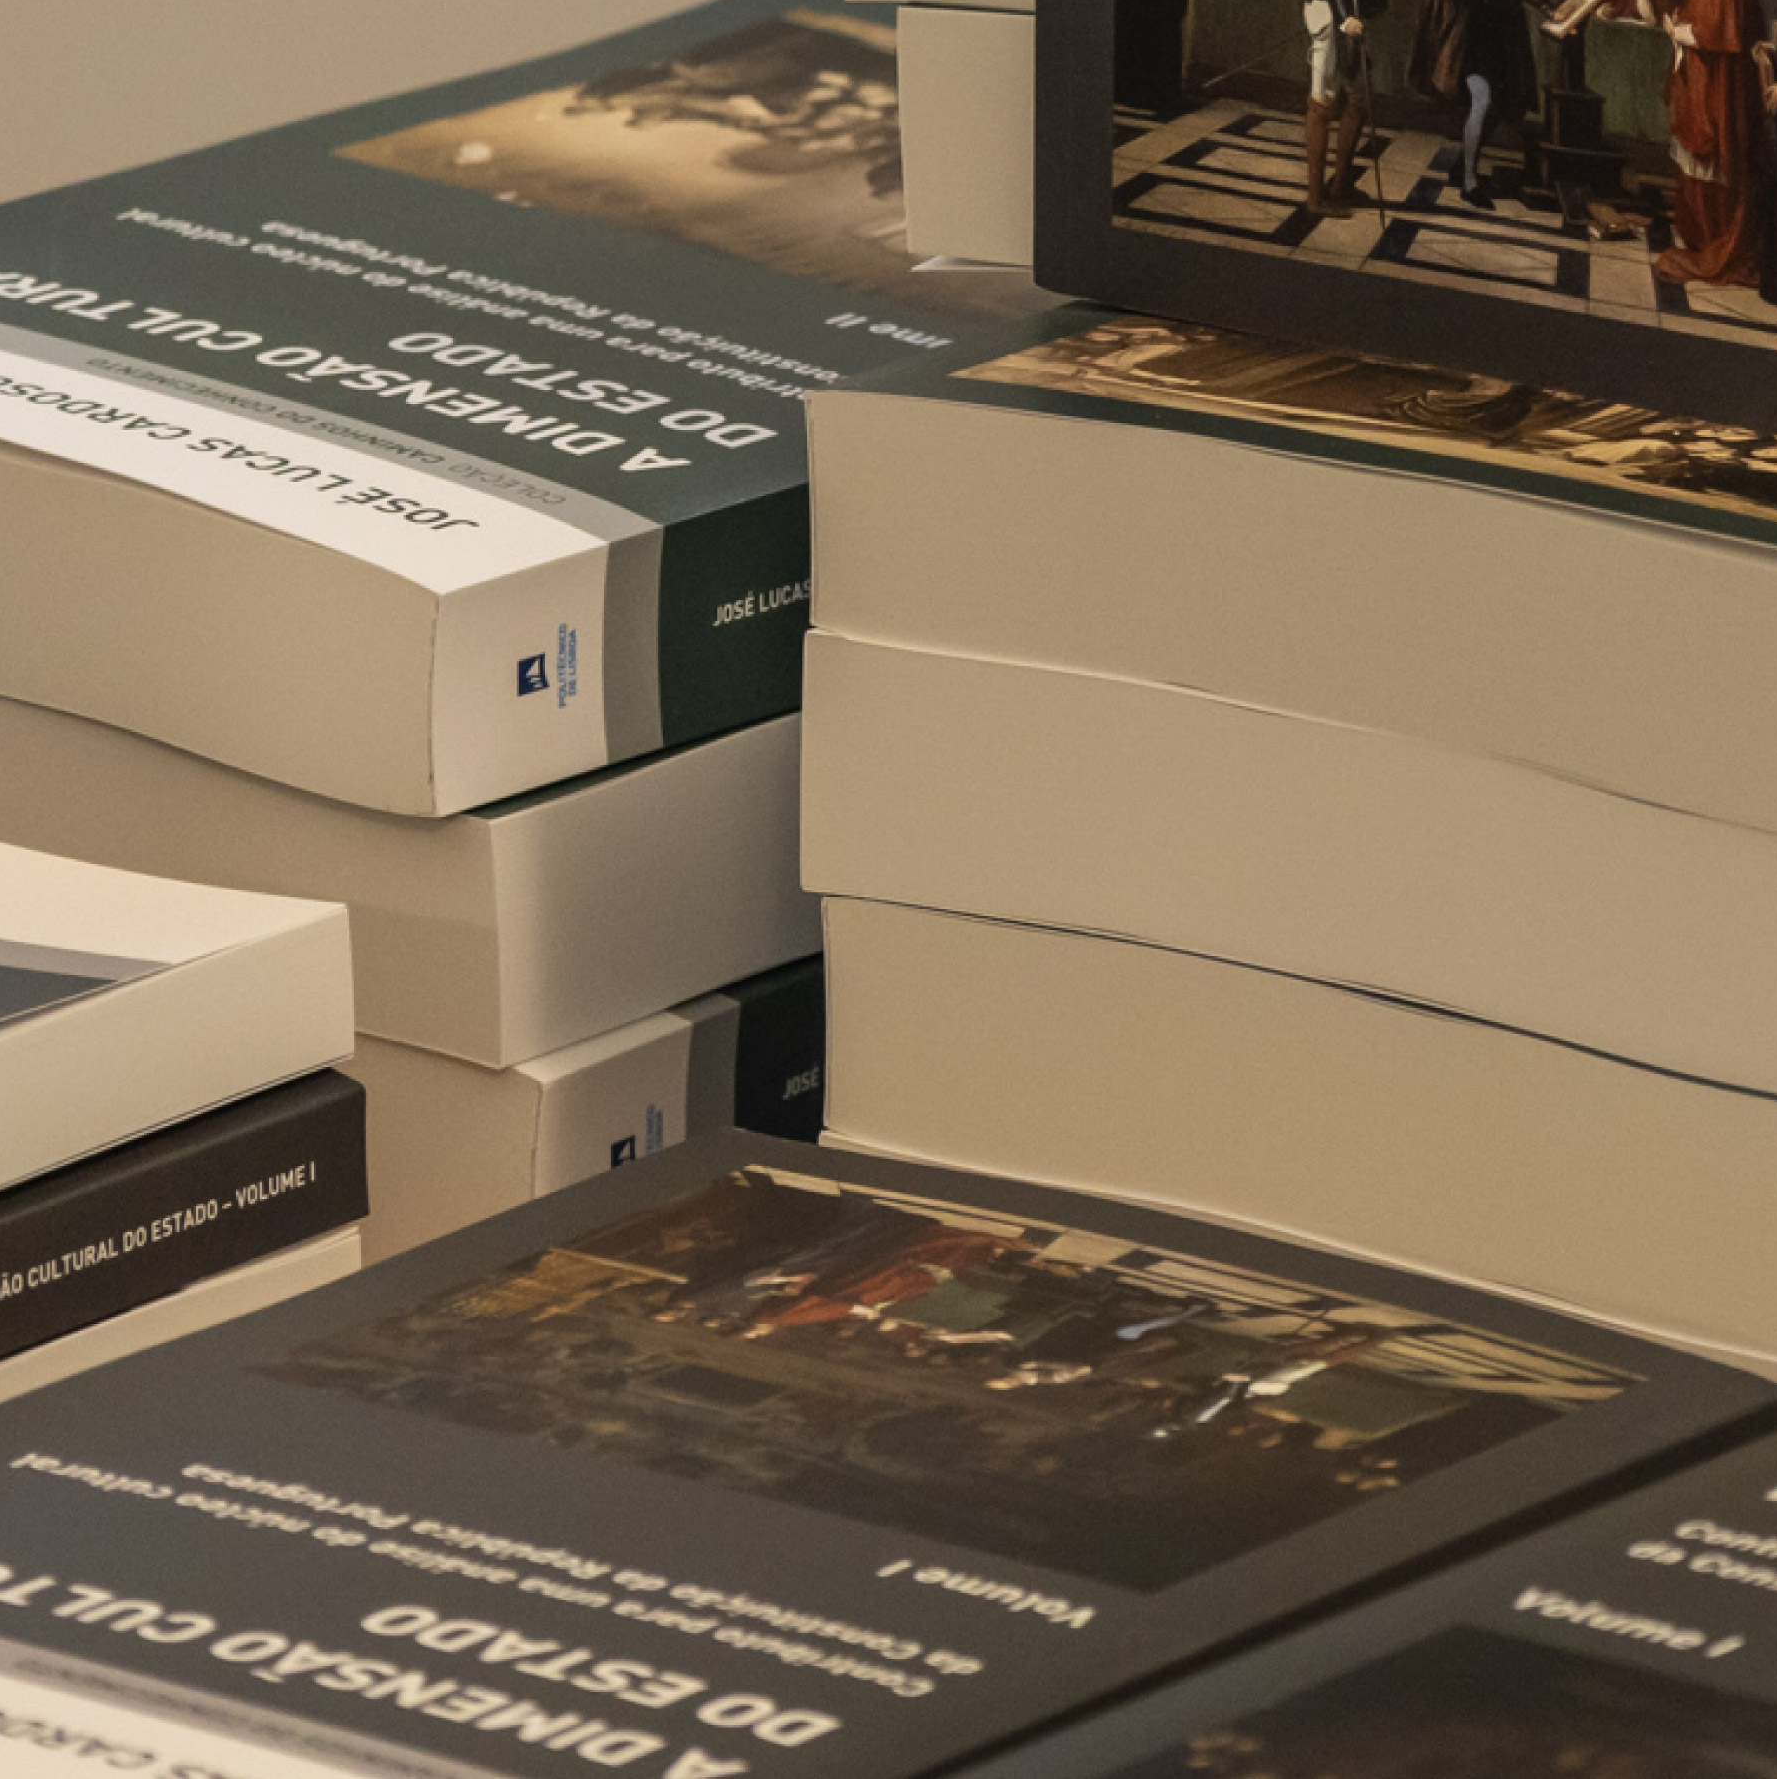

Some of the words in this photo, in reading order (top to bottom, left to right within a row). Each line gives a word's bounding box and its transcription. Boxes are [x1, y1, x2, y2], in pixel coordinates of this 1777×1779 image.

[388, 332, 672, 414] ESTADO
[657, 325, 847, 383] onstituição
[687, 357, 806, 400] tributo
[255, 346, 625, 456] DIMENSÃO
[275, 409, 315, 429] DO
[322, 421, 445, 465] CAMINHOS
[660, 409, 779, 448] DO
[189, 436, 351, 493] LUCAS
[619, 448, 692, 472] A
[449, 461, 567, 504] COLEÇÃO
[334, 486, 480, 530] JOSÉ
[712, 590, 755, 627] JOSÉ
[782, 1065, 820, 1101] JOSÉ
[27, 1238, 119, 1288] CULTURAL
[123, 1226, 147, 1253] DO
[151, 1199, 218, 1242] ESTADO
[235, 1165, 305, 1209] VOLUME
[360, 1605, 708, 1709] ESTADO
[210, 1631, 666, 1767] DIMENSÃO
[696, 1693, 843, 1747] DO
